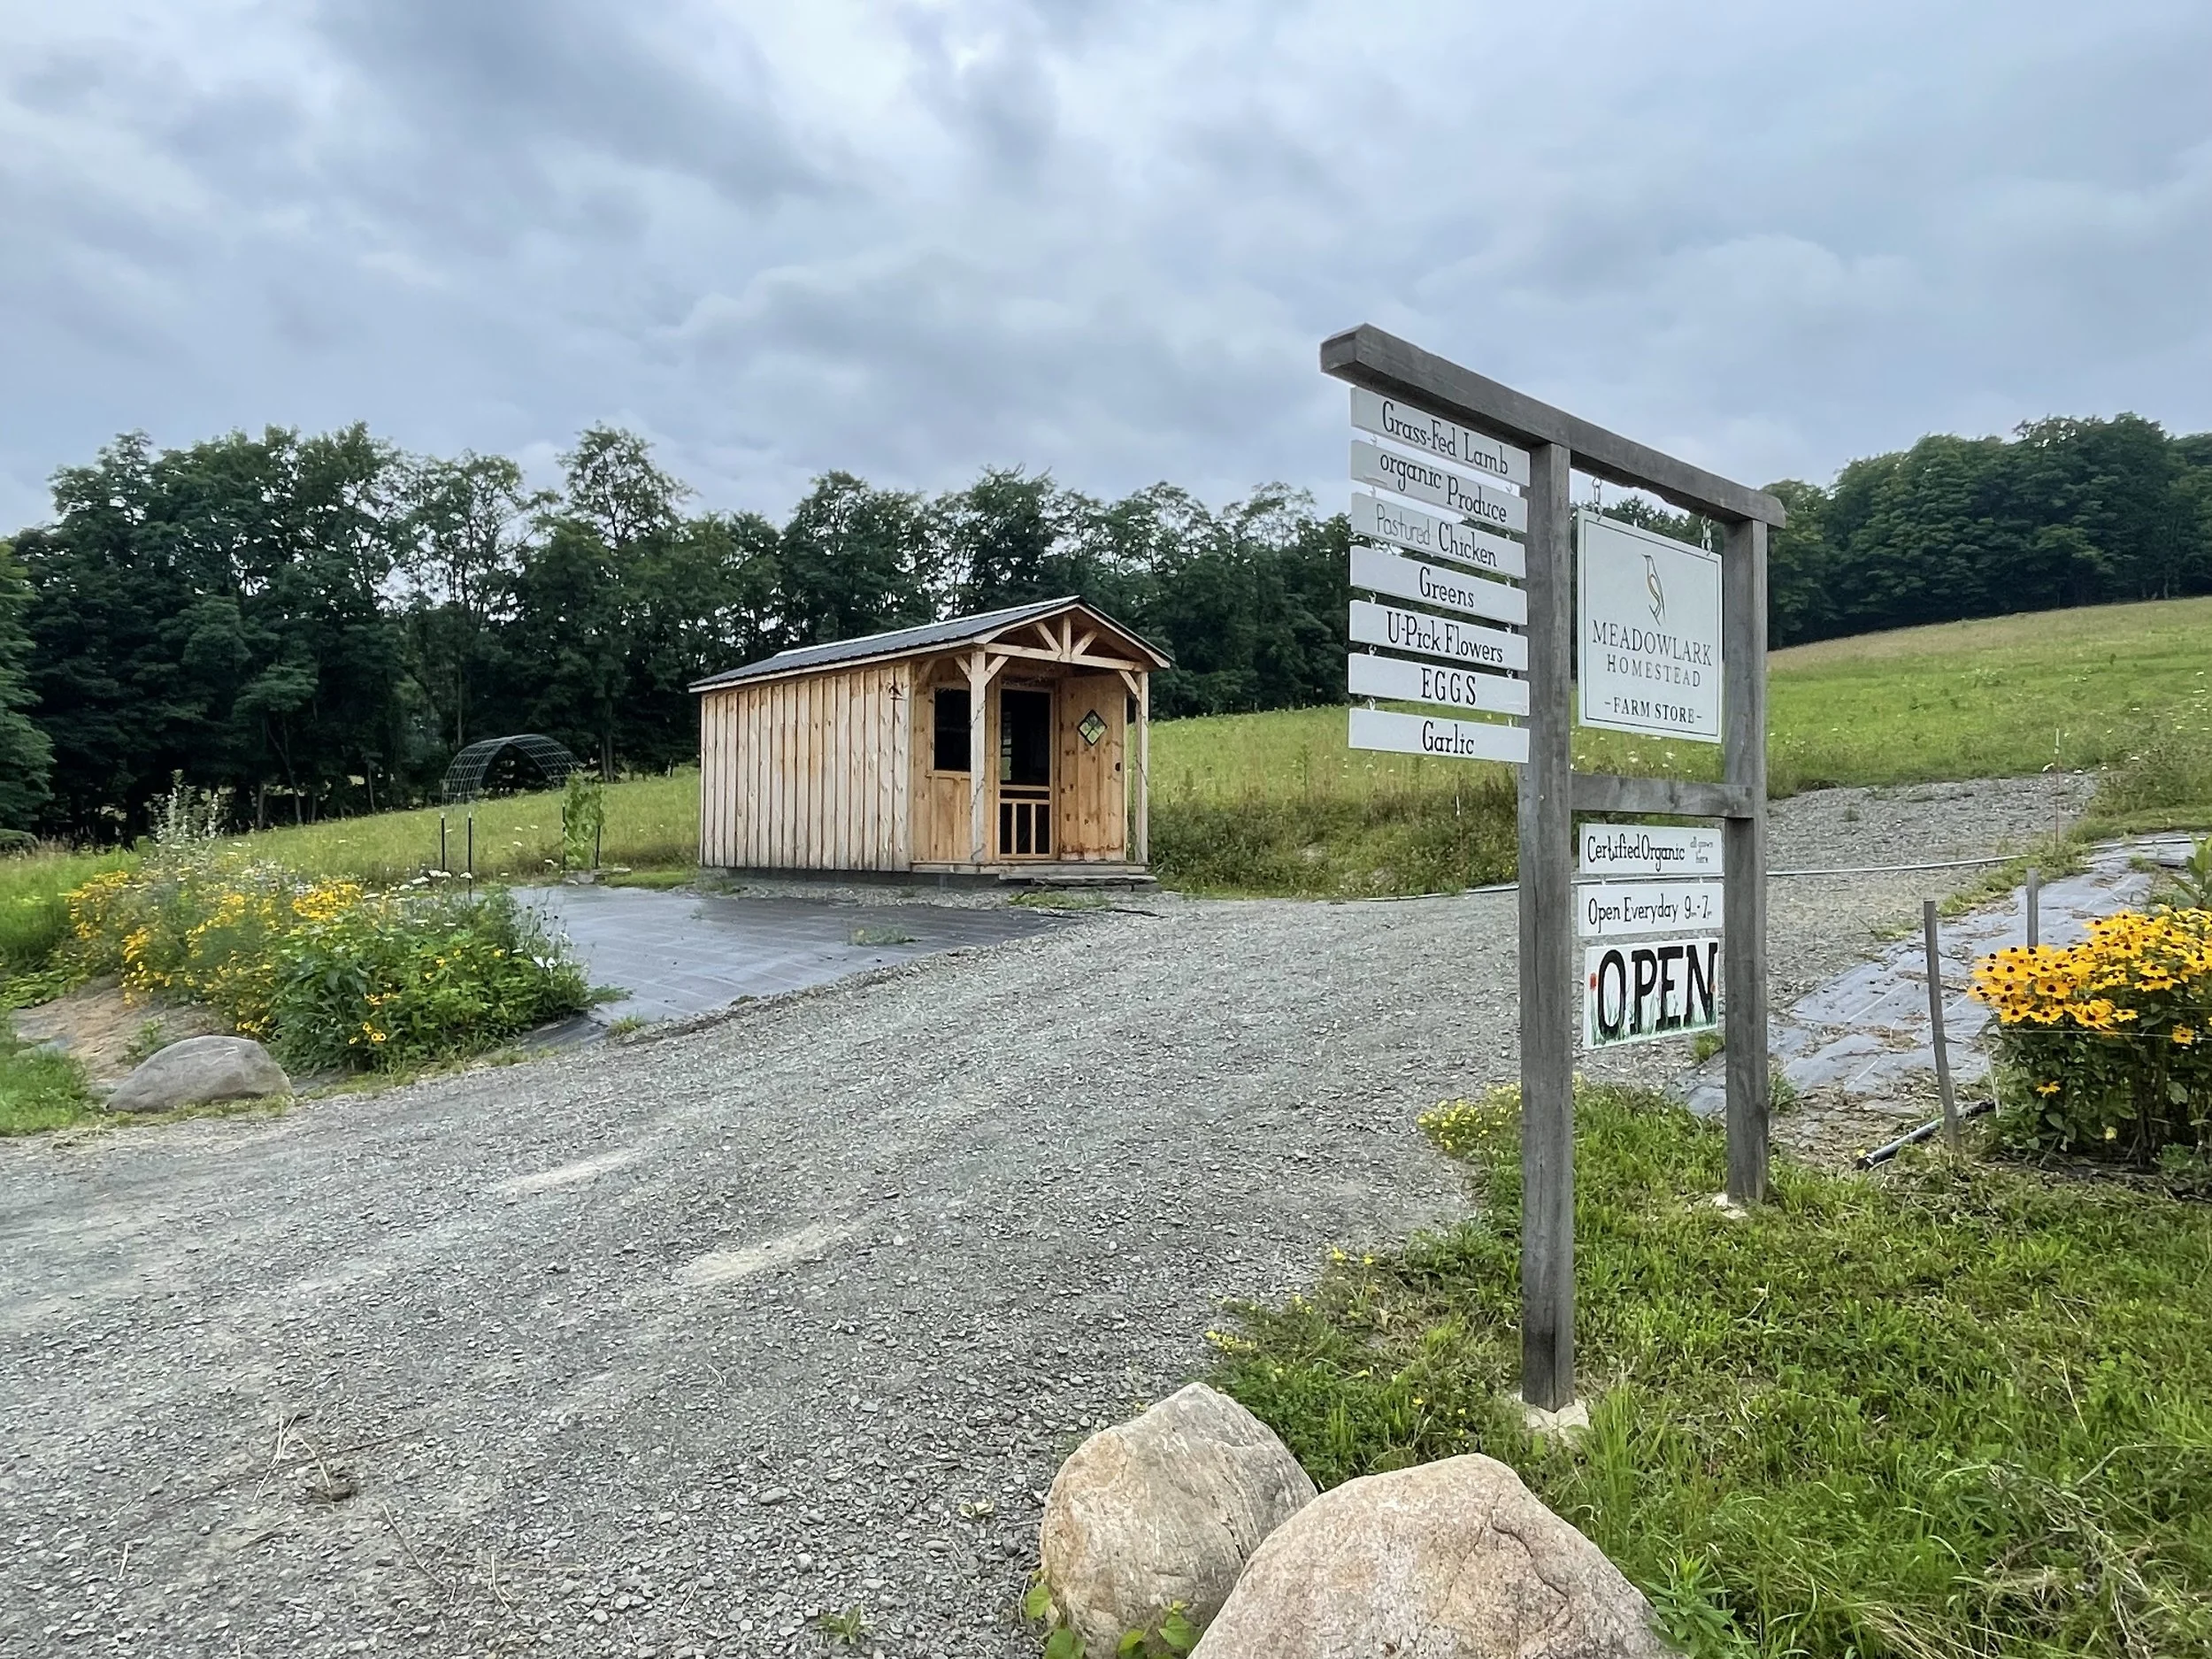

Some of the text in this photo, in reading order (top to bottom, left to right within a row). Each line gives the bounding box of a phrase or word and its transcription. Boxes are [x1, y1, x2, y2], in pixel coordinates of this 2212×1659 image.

[1382, 400, 1509, 476] Grass-Fed Lamb
[1380, 451, 1507, 523] organic Produce
[1376, 503, 1497, 567] Pastured Chicken
[1419, 566, 1475, 608] Greens
[1386, 611, 1503, 664] U-Pick Flowers
[1593, 618, 1712, 666] MEADOWLARK
[1421, 667, 1477, 706] EGGS
[1607, 653, 1701, 687] HOMESTEAD
[1422, 719, 1475, 756] Garlic
[1587, 833, 1685, 872] Certified Organic
[1588, 897, 1621, 933] Open
[1624, 893, 1678, 924] Everyday
[1597, 941, 1718, 1041] OPEN
